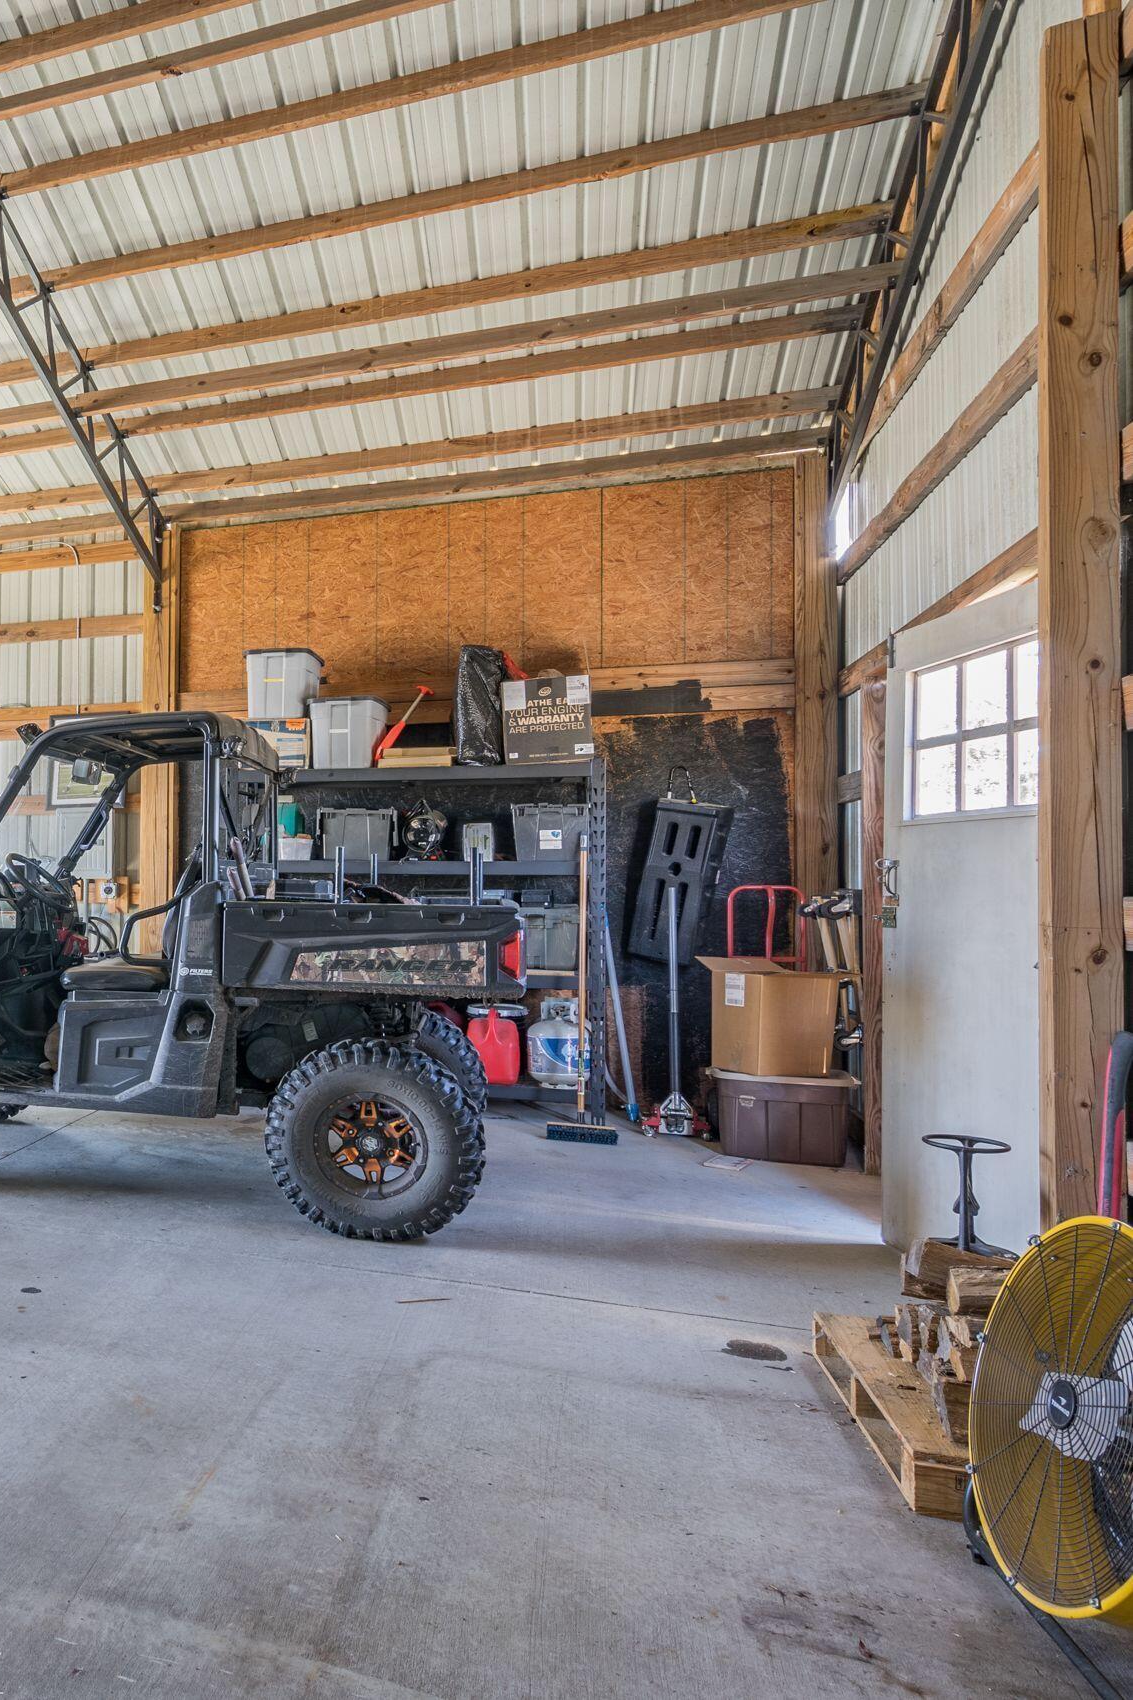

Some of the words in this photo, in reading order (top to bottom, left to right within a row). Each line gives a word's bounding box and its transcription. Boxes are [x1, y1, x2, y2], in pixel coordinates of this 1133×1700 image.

[527, 699, 552, 707] ATHE
[509, 708, 538, 717] YOUR
[542, 704, 584, 715] ENGINE
[518, 713, 584, 725] WARRANTY
[509, 726, 527, 734] ARE
[327, 958, 478, 974] RANGER
